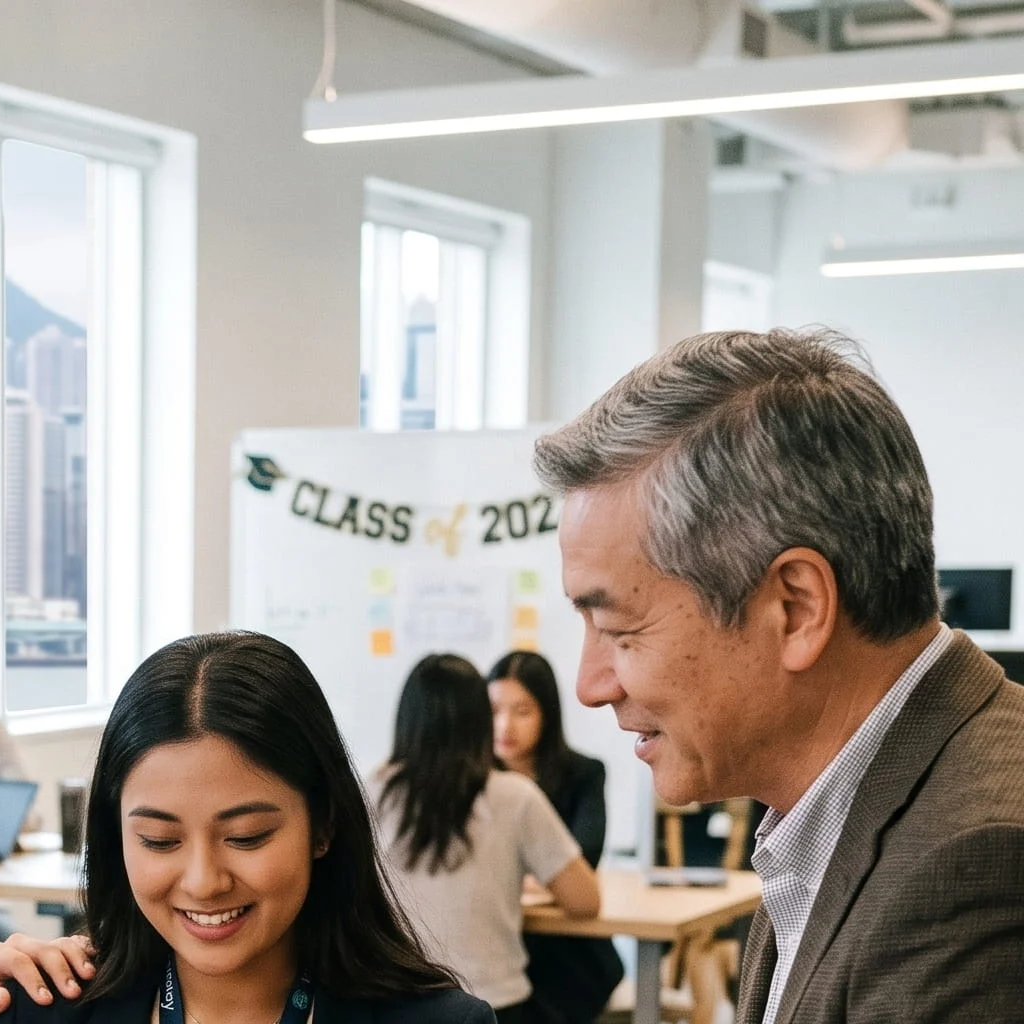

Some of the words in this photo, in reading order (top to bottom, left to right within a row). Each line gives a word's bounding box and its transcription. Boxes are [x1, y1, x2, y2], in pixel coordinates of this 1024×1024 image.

[291, 479, 413, 543] CLASS
[424, 502, 467, 557] of
[481, 494, 559, 543] 202
